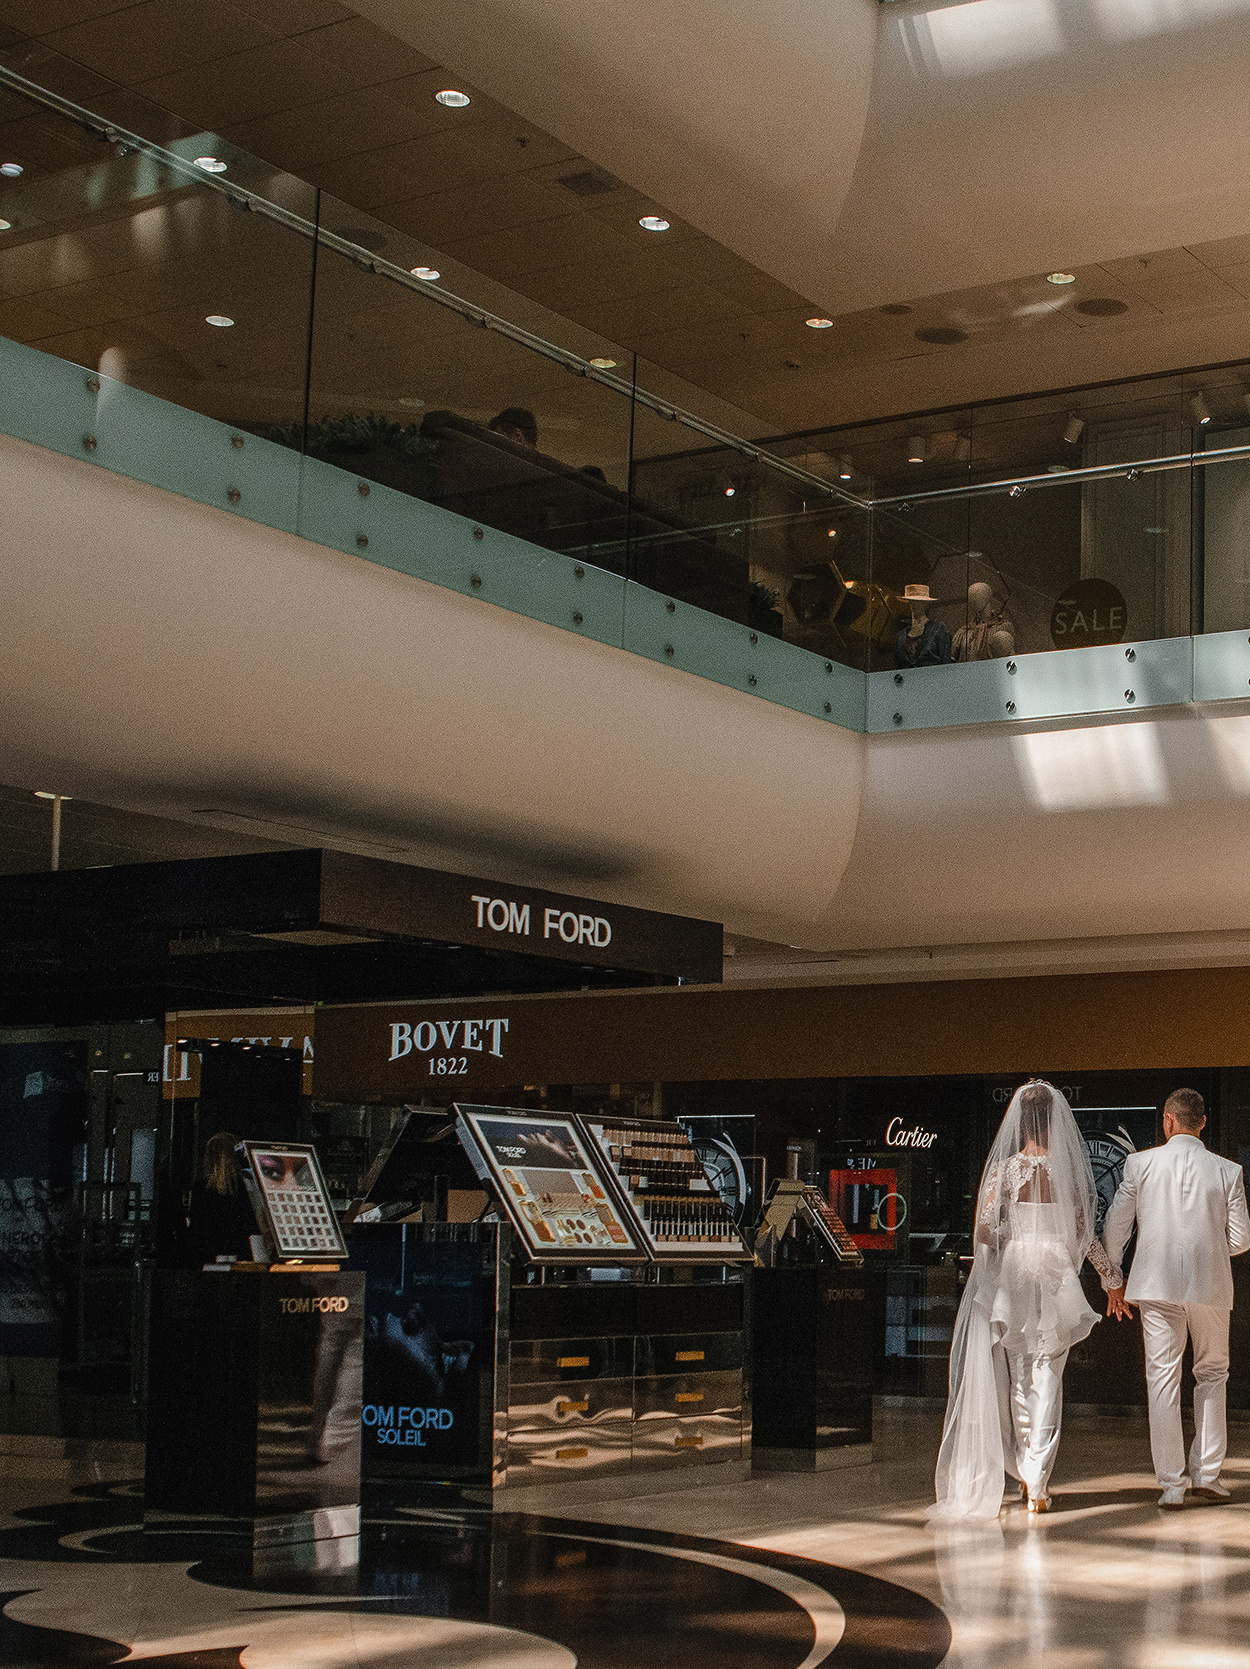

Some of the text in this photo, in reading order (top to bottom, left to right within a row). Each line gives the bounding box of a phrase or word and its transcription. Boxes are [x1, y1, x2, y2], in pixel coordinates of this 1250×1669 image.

[1055, 606, 1122, 635] SALE
[471, 894, 612, 948] TOM FORD
[388, 1018, 509, 1062] BOVET
[428, 1056, 468, 1076] 1822
[885, 1116, 938, 1149] Cartier
[279, 1296, 350, 1314] TOM FORD
[361, 1404, 454, 1430] OM FORD
[376, 1427, 427, 1448] SOLEIL
